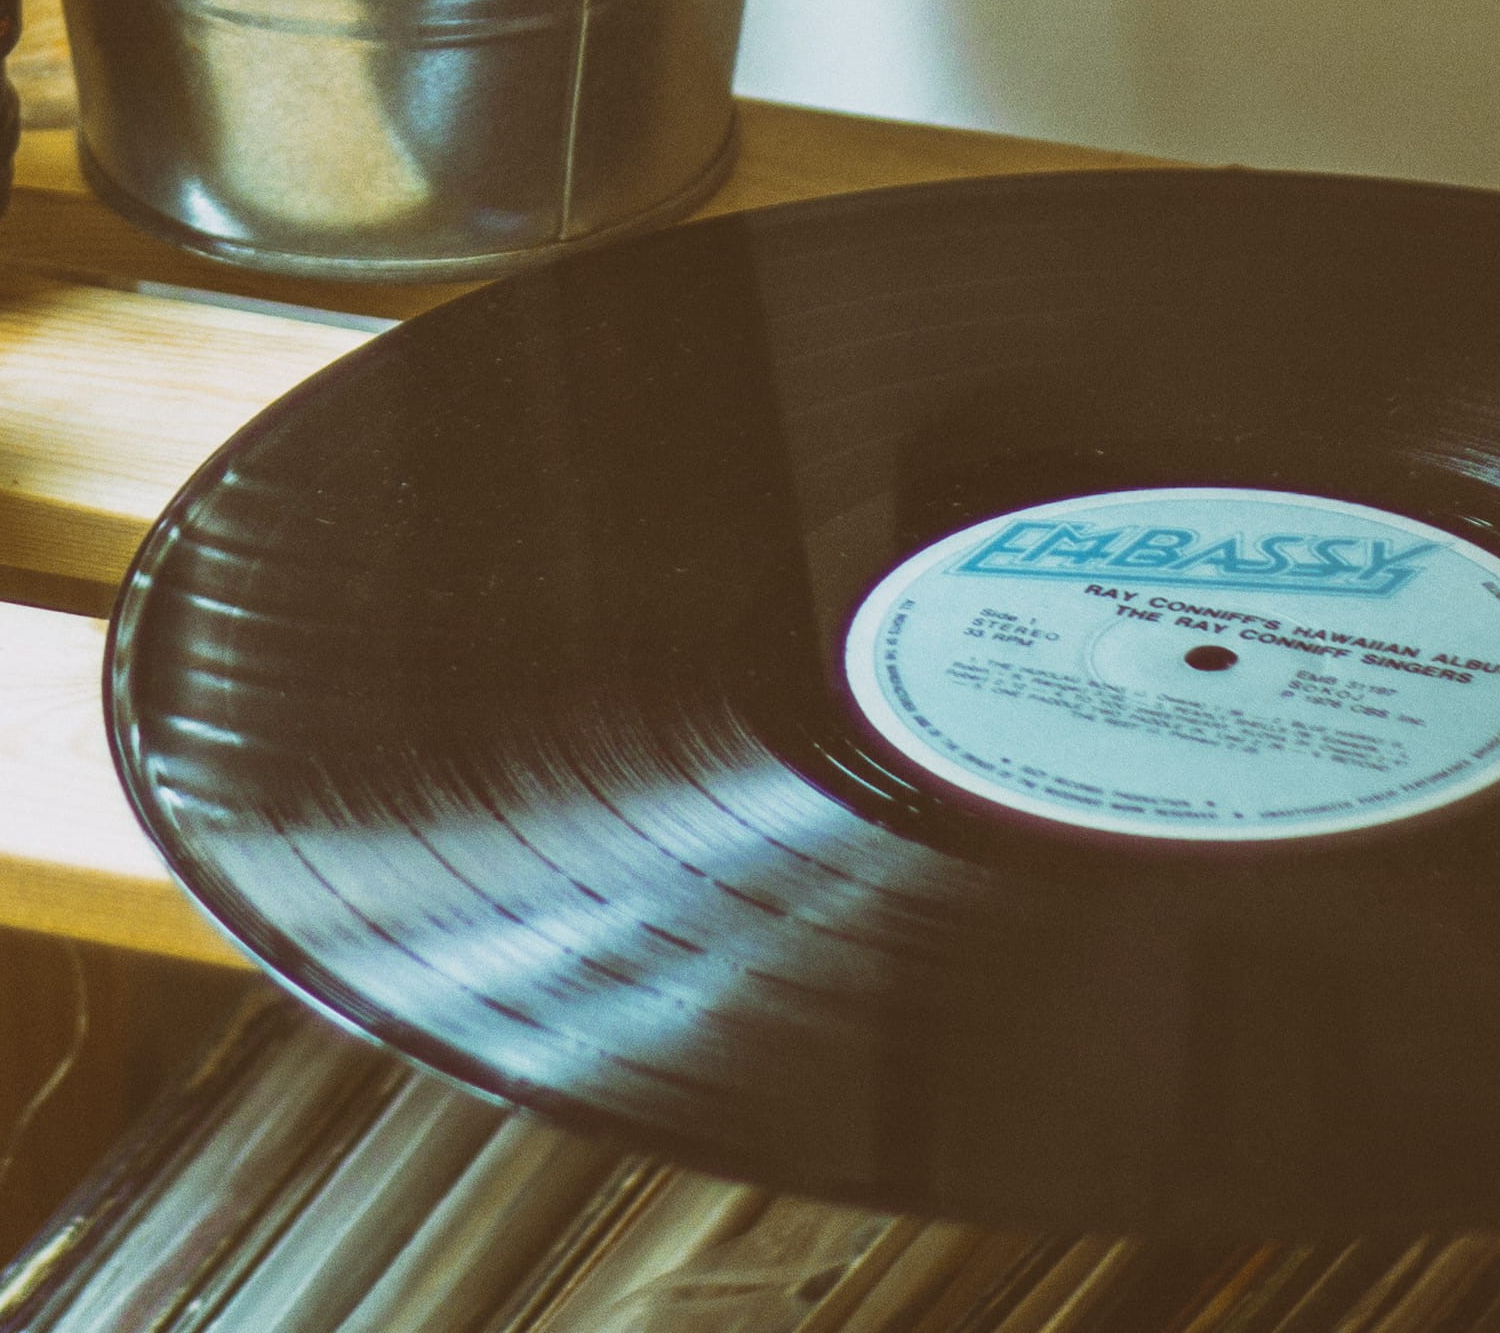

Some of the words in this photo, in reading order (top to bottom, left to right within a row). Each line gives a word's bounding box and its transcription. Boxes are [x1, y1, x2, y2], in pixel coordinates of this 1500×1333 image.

[955, 518, 1440, 589] EMBASSY
[971, 616, 1061, 642] STEREO
[1084, 583, 1139, 602] RAY
[1148, 596, 1282, 631] CONNIFF'S
[1292, 626, 1421, 659] HAWAIIAN
[1115, 604, 1164, 622] THE
[1173, 615, 1229, 635] RAY
[1239, 628, 1352, 659] CONNIFF
[1360, 653, 1475, 685] SINGERS
